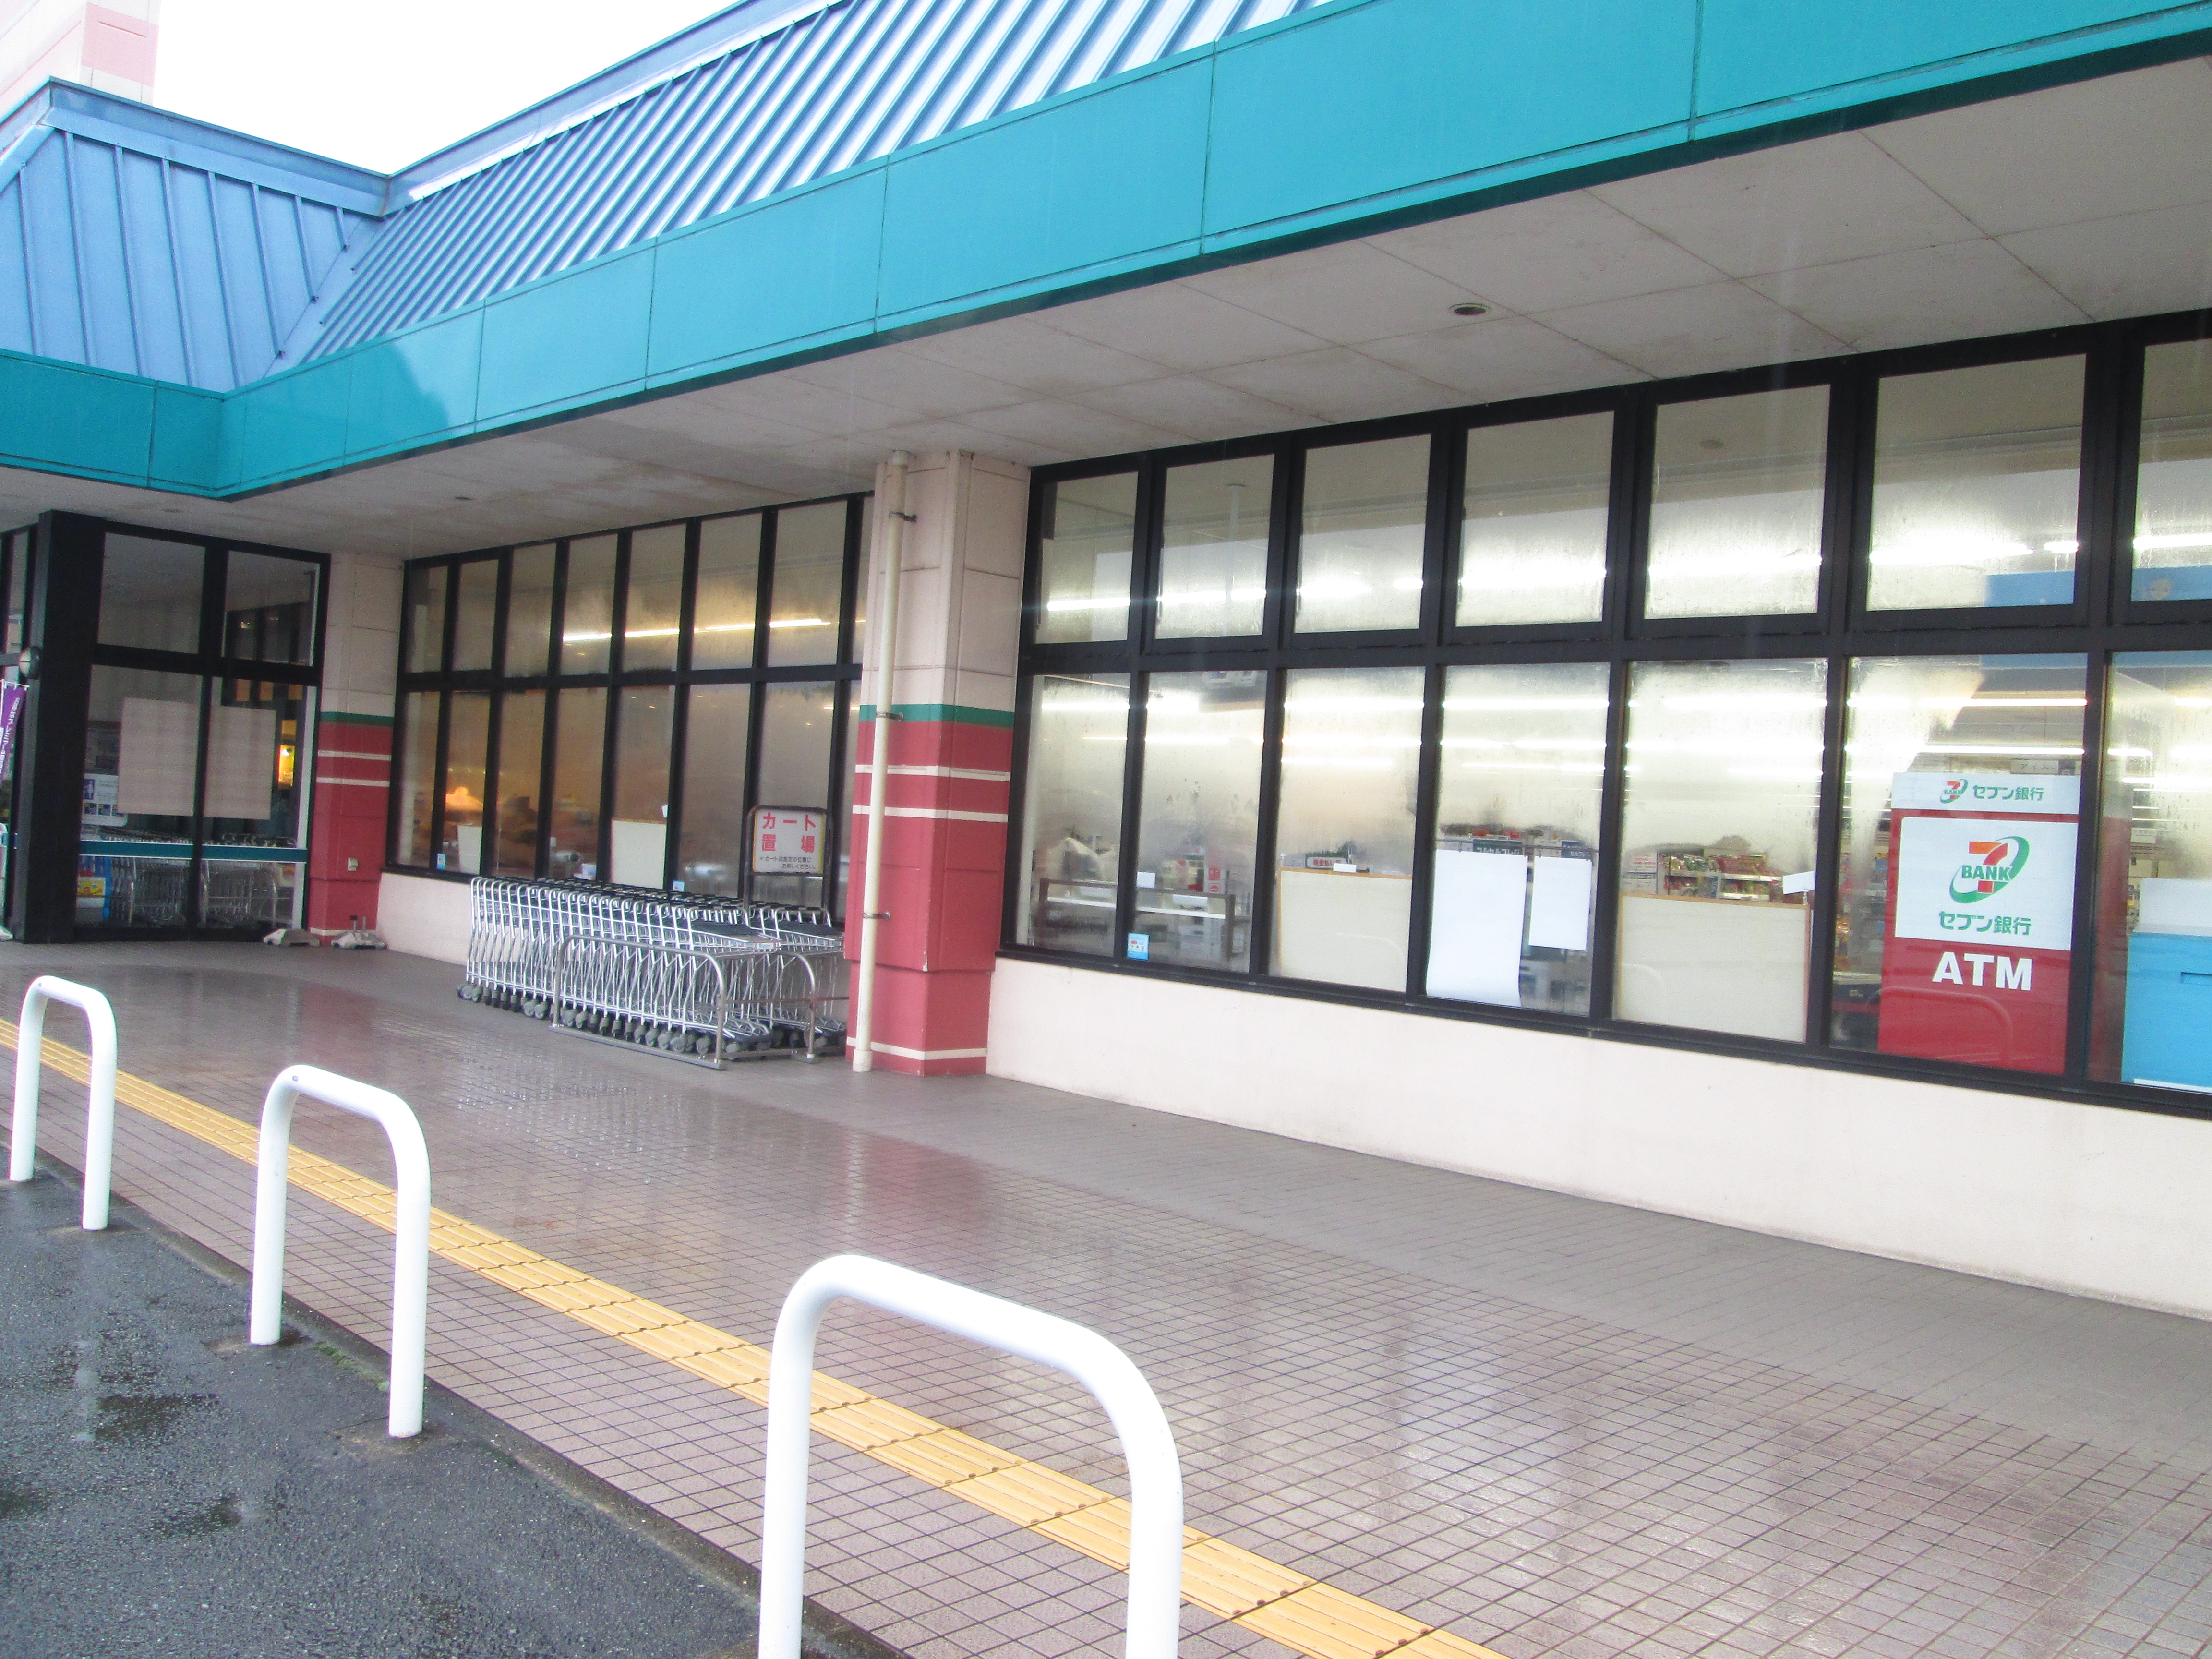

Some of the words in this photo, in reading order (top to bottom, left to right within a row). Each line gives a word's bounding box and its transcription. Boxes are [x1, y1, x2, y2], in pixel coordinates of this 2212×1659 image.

[1973, 785, 2044, 801] セブン銀行
[762, 812, 816, 831] カート
[1961, 865, 2013, 881] BANK
[1938, 911, 2032, 936] セブン銀行
[1932, 951, 2032, 992] ATM
